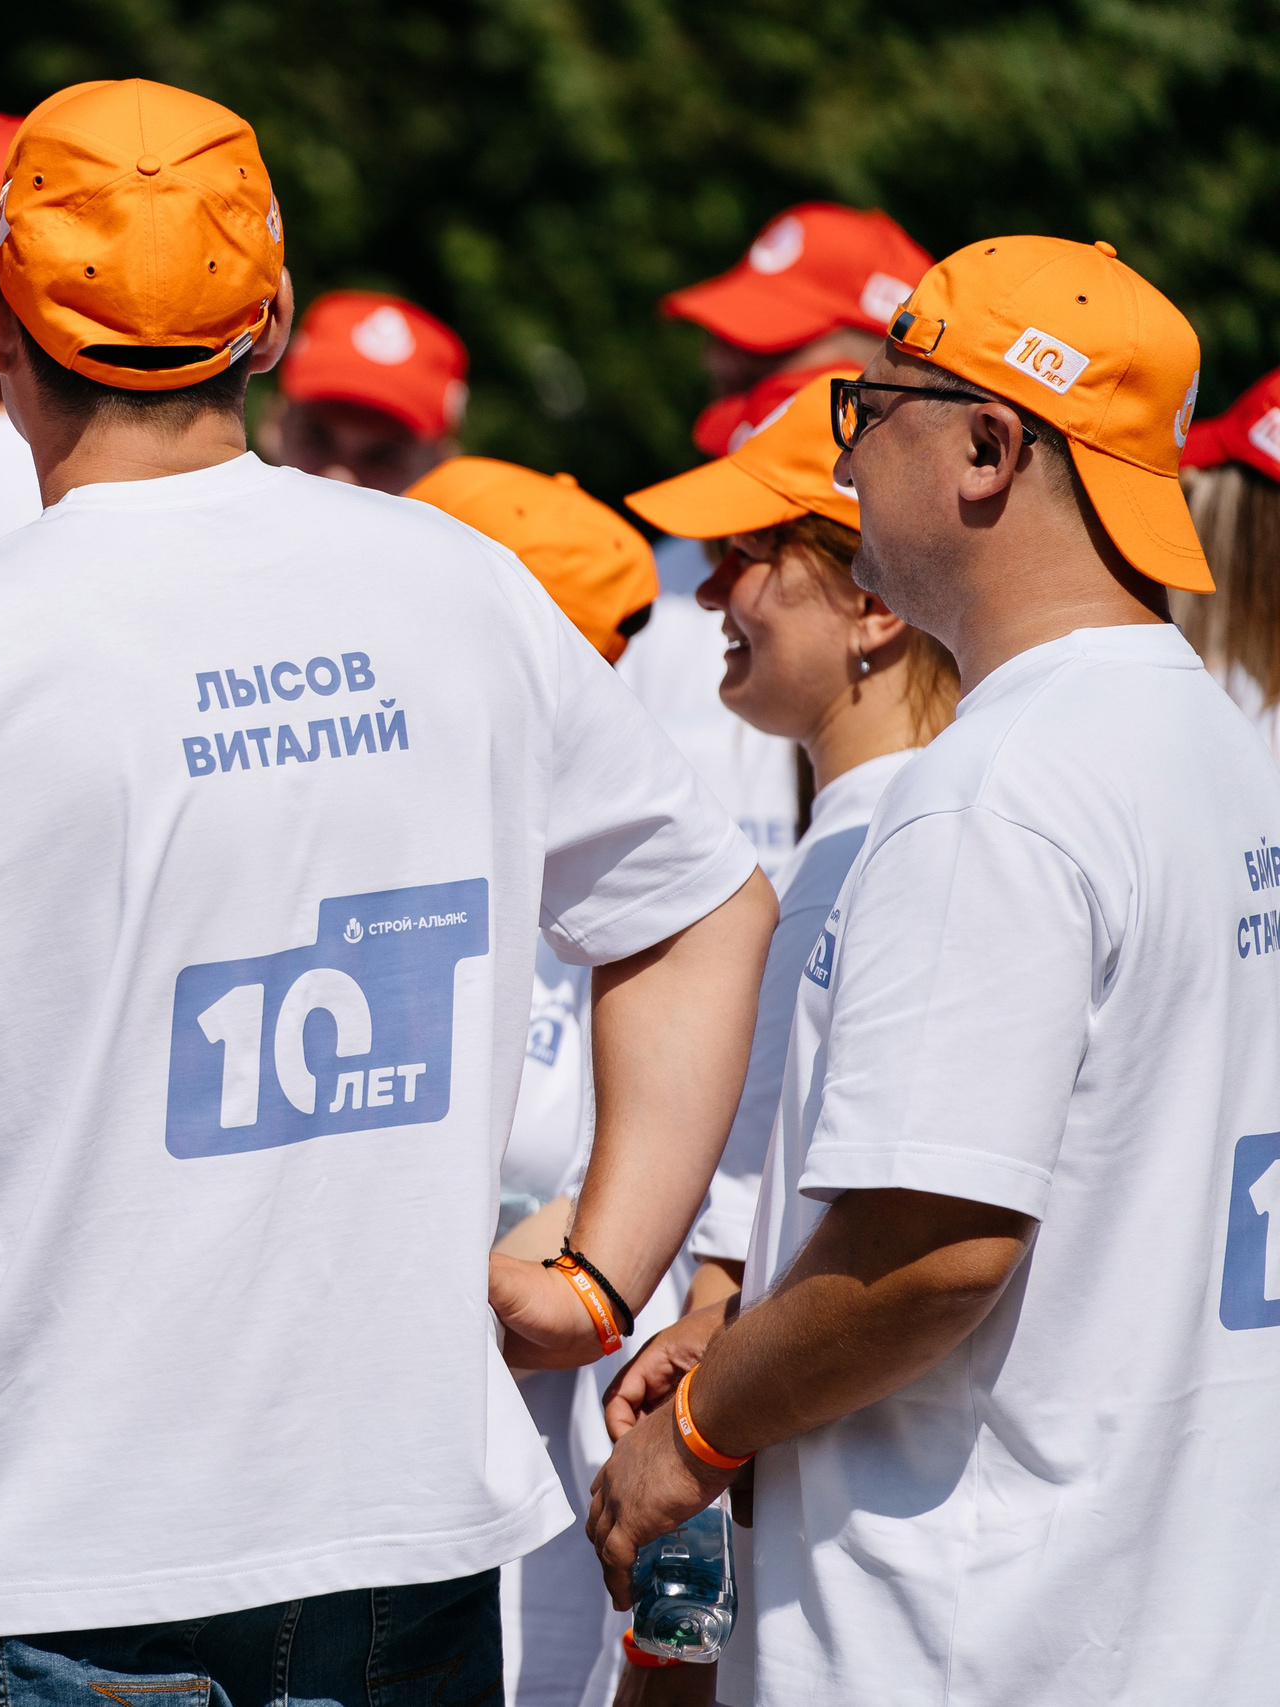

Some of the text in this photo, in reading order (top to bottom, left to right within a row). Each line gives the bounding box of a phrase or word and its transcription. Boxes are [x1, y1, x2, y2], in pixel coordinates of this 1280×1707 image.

[1016, 336, 1064, 373] 10
[1041, 371, 1067, 387] ЛЕТ
[195, 651, 376, 713] ЛЫСОВ
[182, 698, 410, 778] ВИТАЛИЙ
[368, 910, 468, 936] СТРОЙ-АЛЬЯНС
[196, 967, 373, 1130] 10
[328, 1062, 427, 1114] ЛЕТ
[588, 1291, 613, 1336] СТРОЙ-АЛЬЯНС
